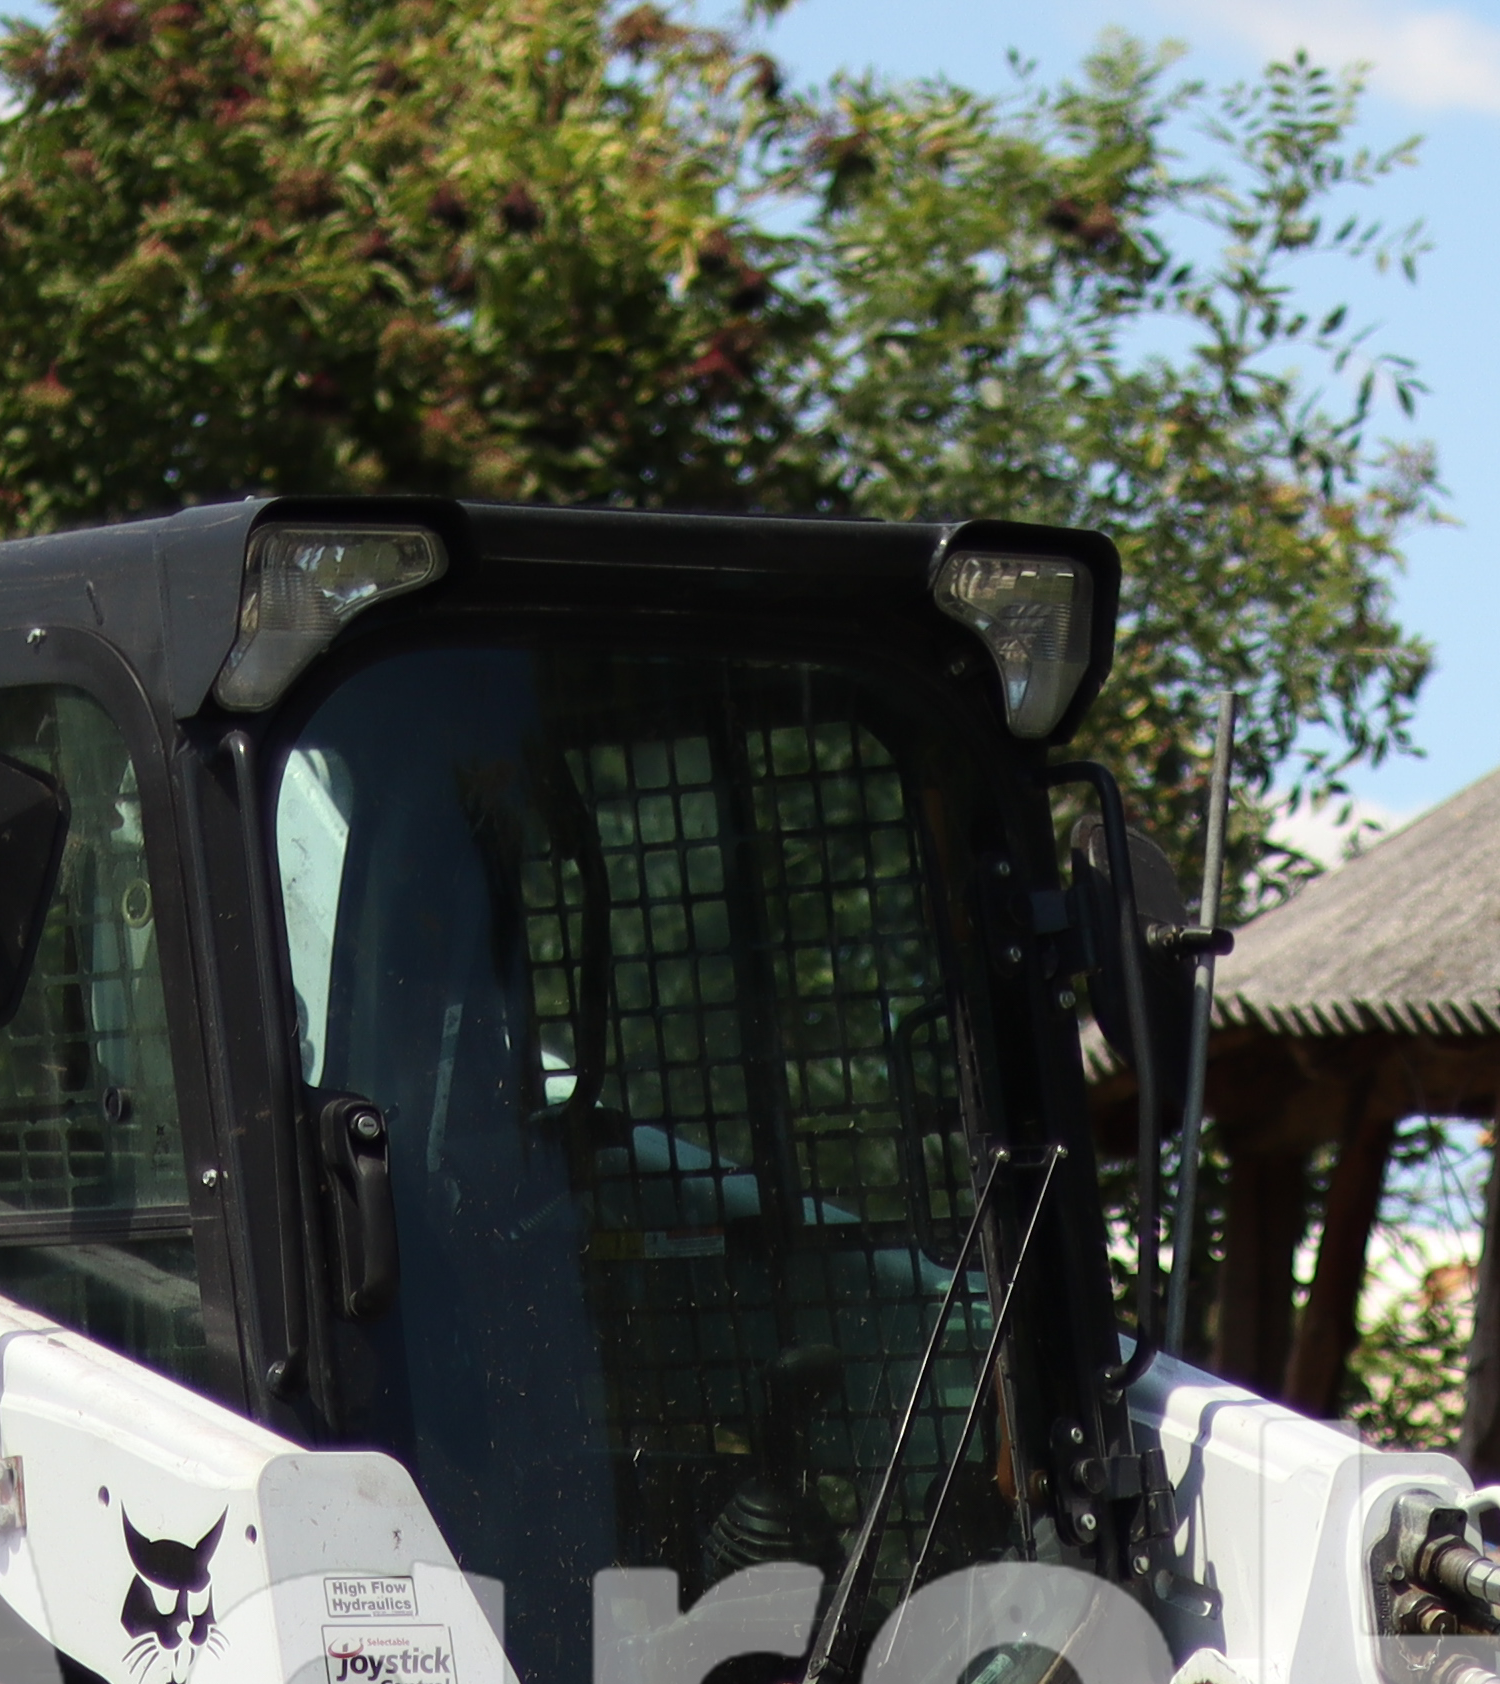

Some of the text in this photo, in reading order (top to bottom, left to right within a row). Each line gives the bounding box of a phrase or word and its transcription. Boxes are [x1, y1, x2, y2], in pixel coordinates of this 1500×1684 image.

[332, 1581, 407, 1597] High Flow
[332, 1598, 412, 1613] Hydraulics
[367, 1638, 410, 1647] Selectable
